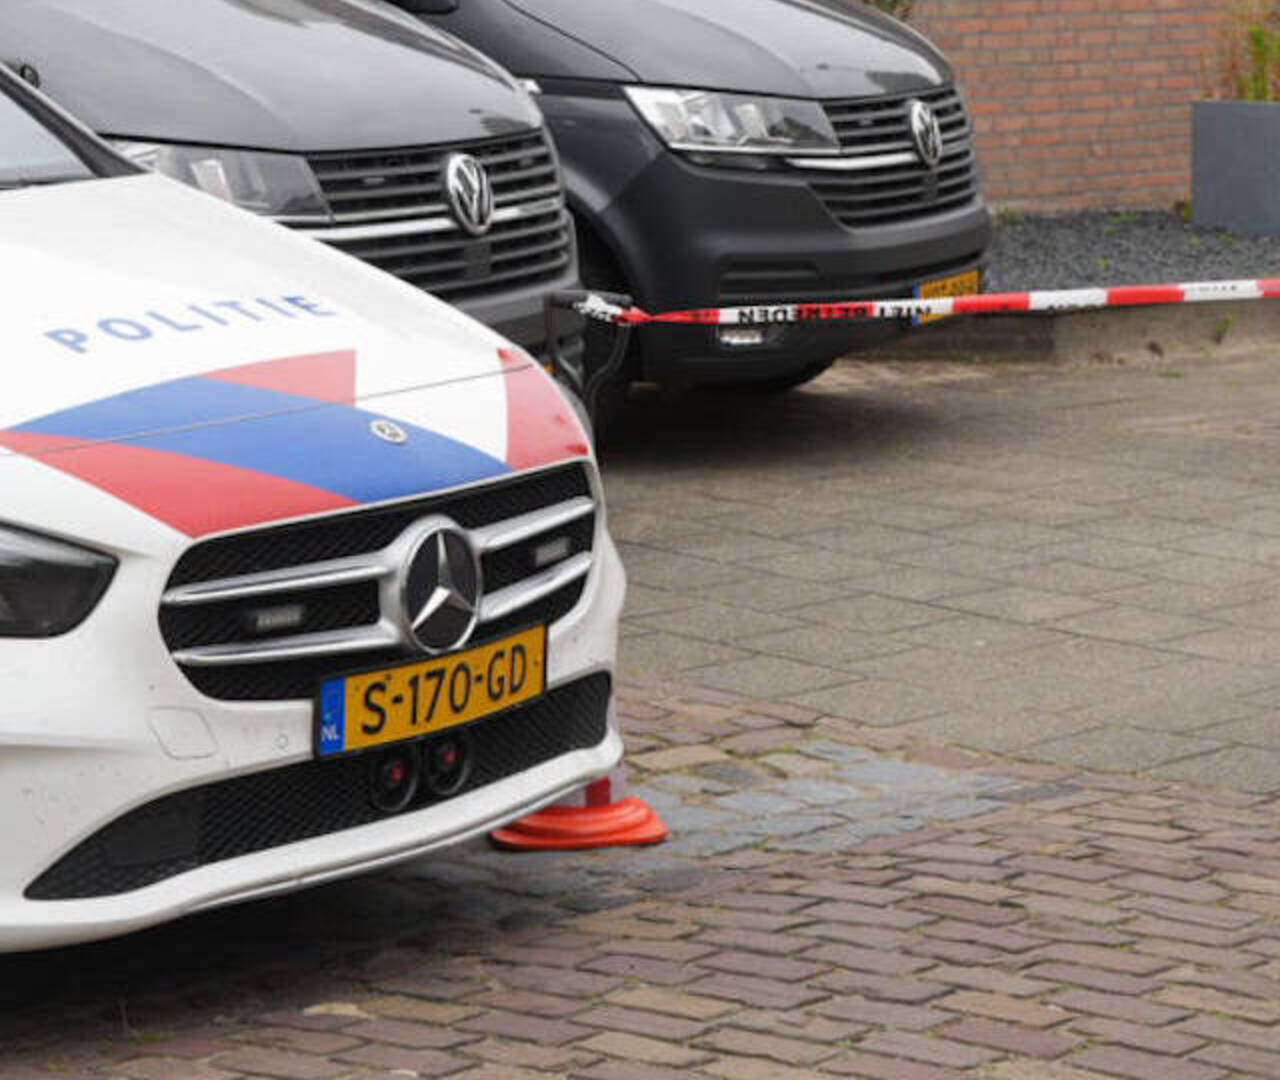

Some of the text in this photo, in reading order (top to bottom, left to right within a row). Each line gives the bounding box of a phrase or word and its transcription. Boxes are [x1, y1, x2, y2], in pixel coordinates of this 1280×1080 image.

[43, 295, 337, 354] POLITIE
[361, 643, 527, 736] S-170-GD
[321, 721, 341, 743] NL
